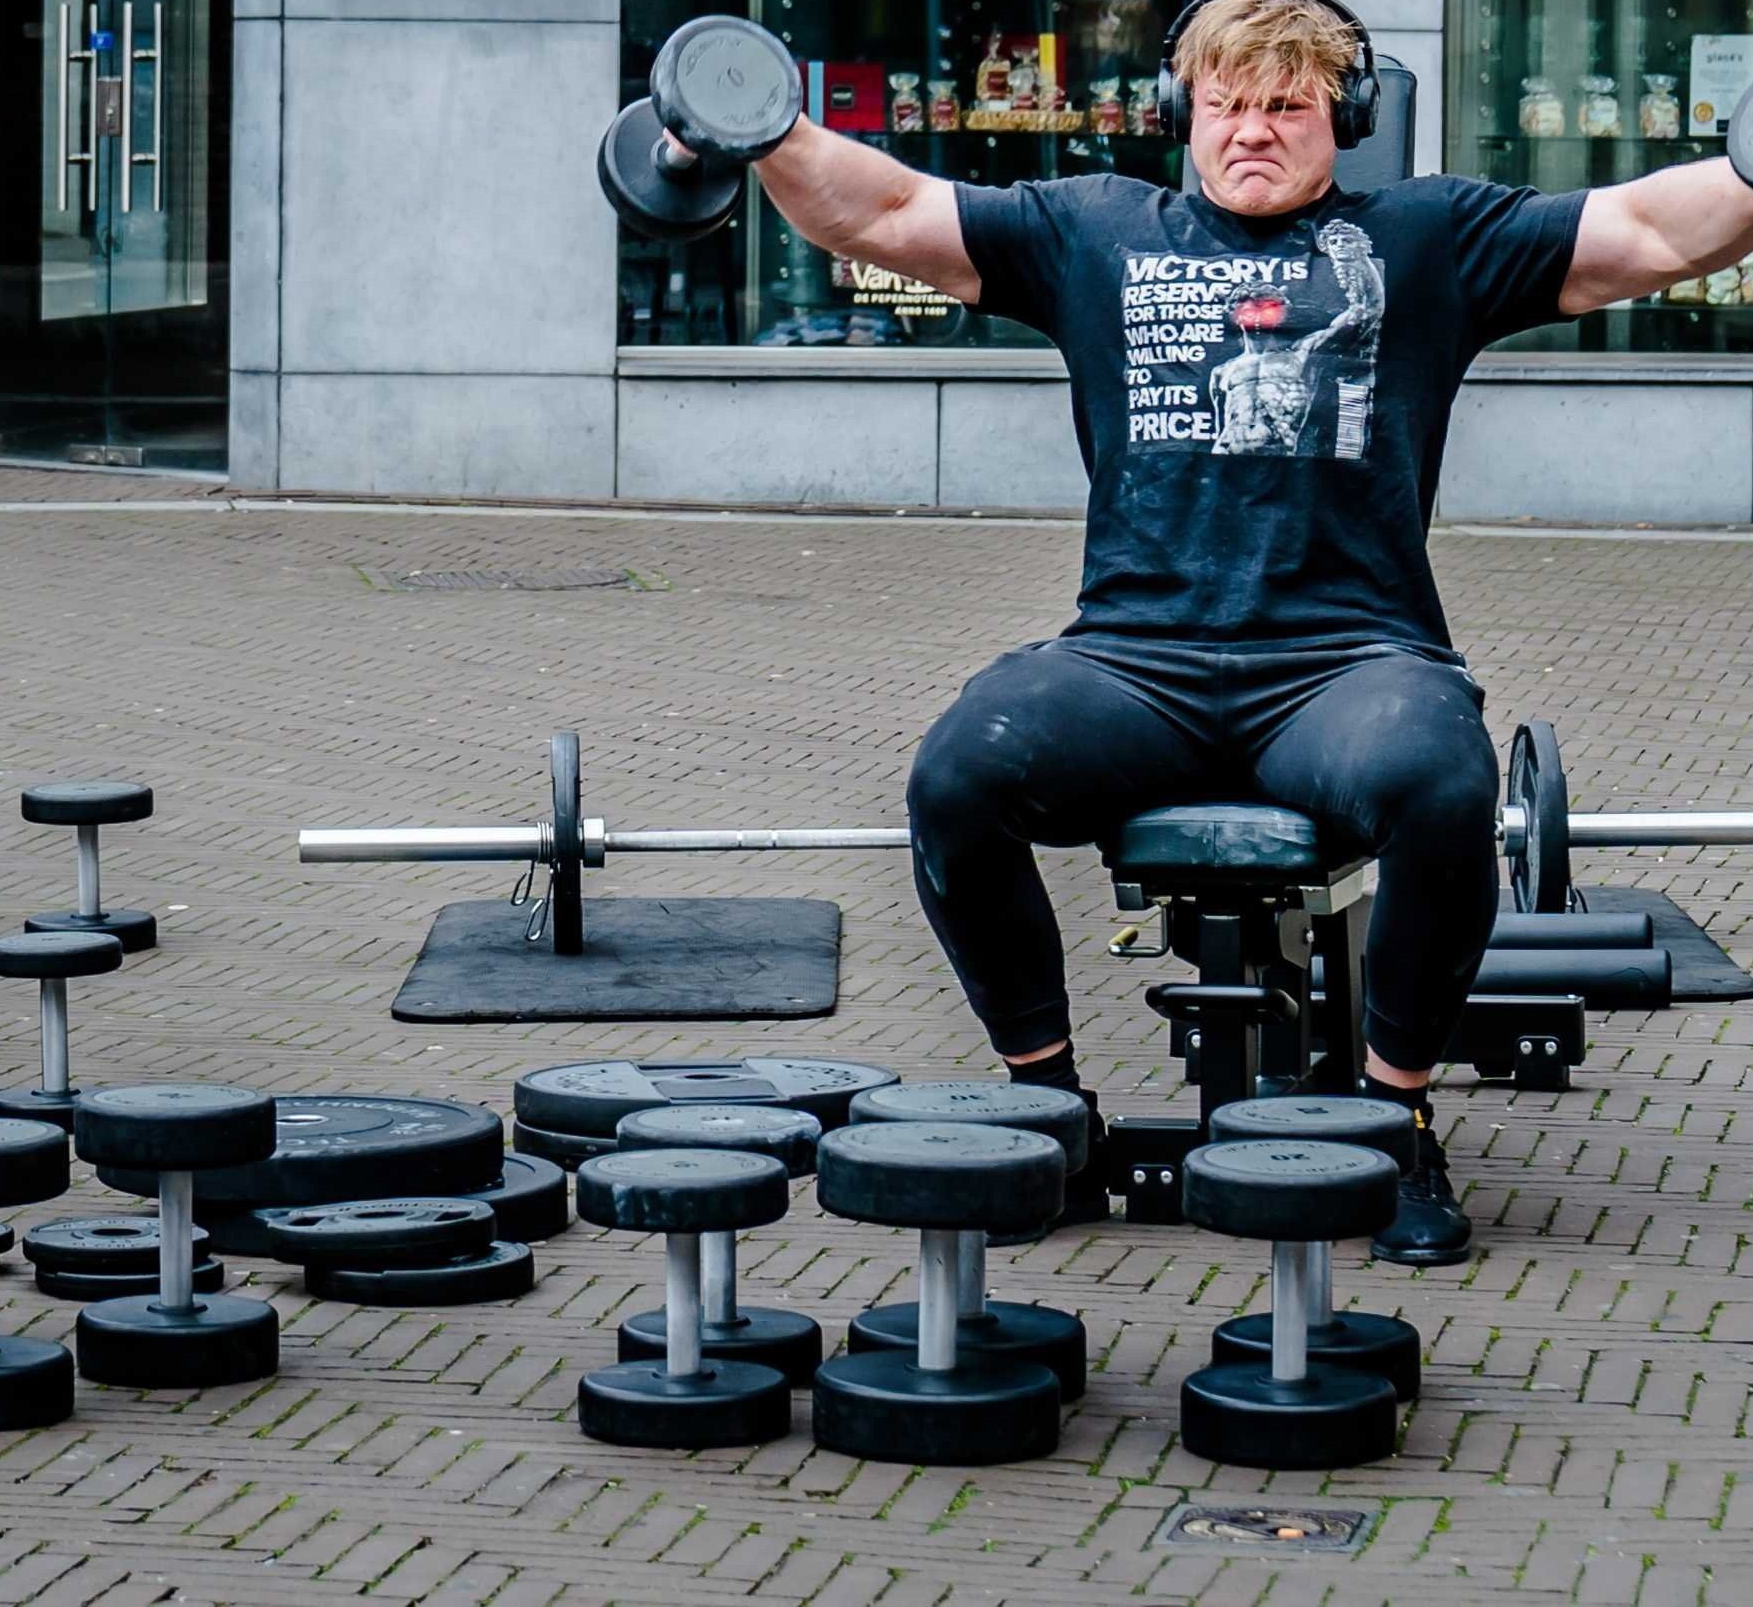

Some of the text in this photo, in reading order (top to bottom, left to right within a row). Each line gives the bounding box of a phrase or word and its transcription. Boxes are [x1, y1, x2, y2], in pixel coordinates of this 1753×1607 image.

[1126, 254, 1308, 283] VICTORY IS
[1124, 303, 1224, 325] FOR THOSE
[1126, 322, 1224, 347] WHO ARE
[1127, 345, 1206, 367] WILLING
[1128, 367, 1151, 385] TO
[1129, 385, 1198, 409] PAY ITS
[1129, 411, 1219, 442] PRICE.
